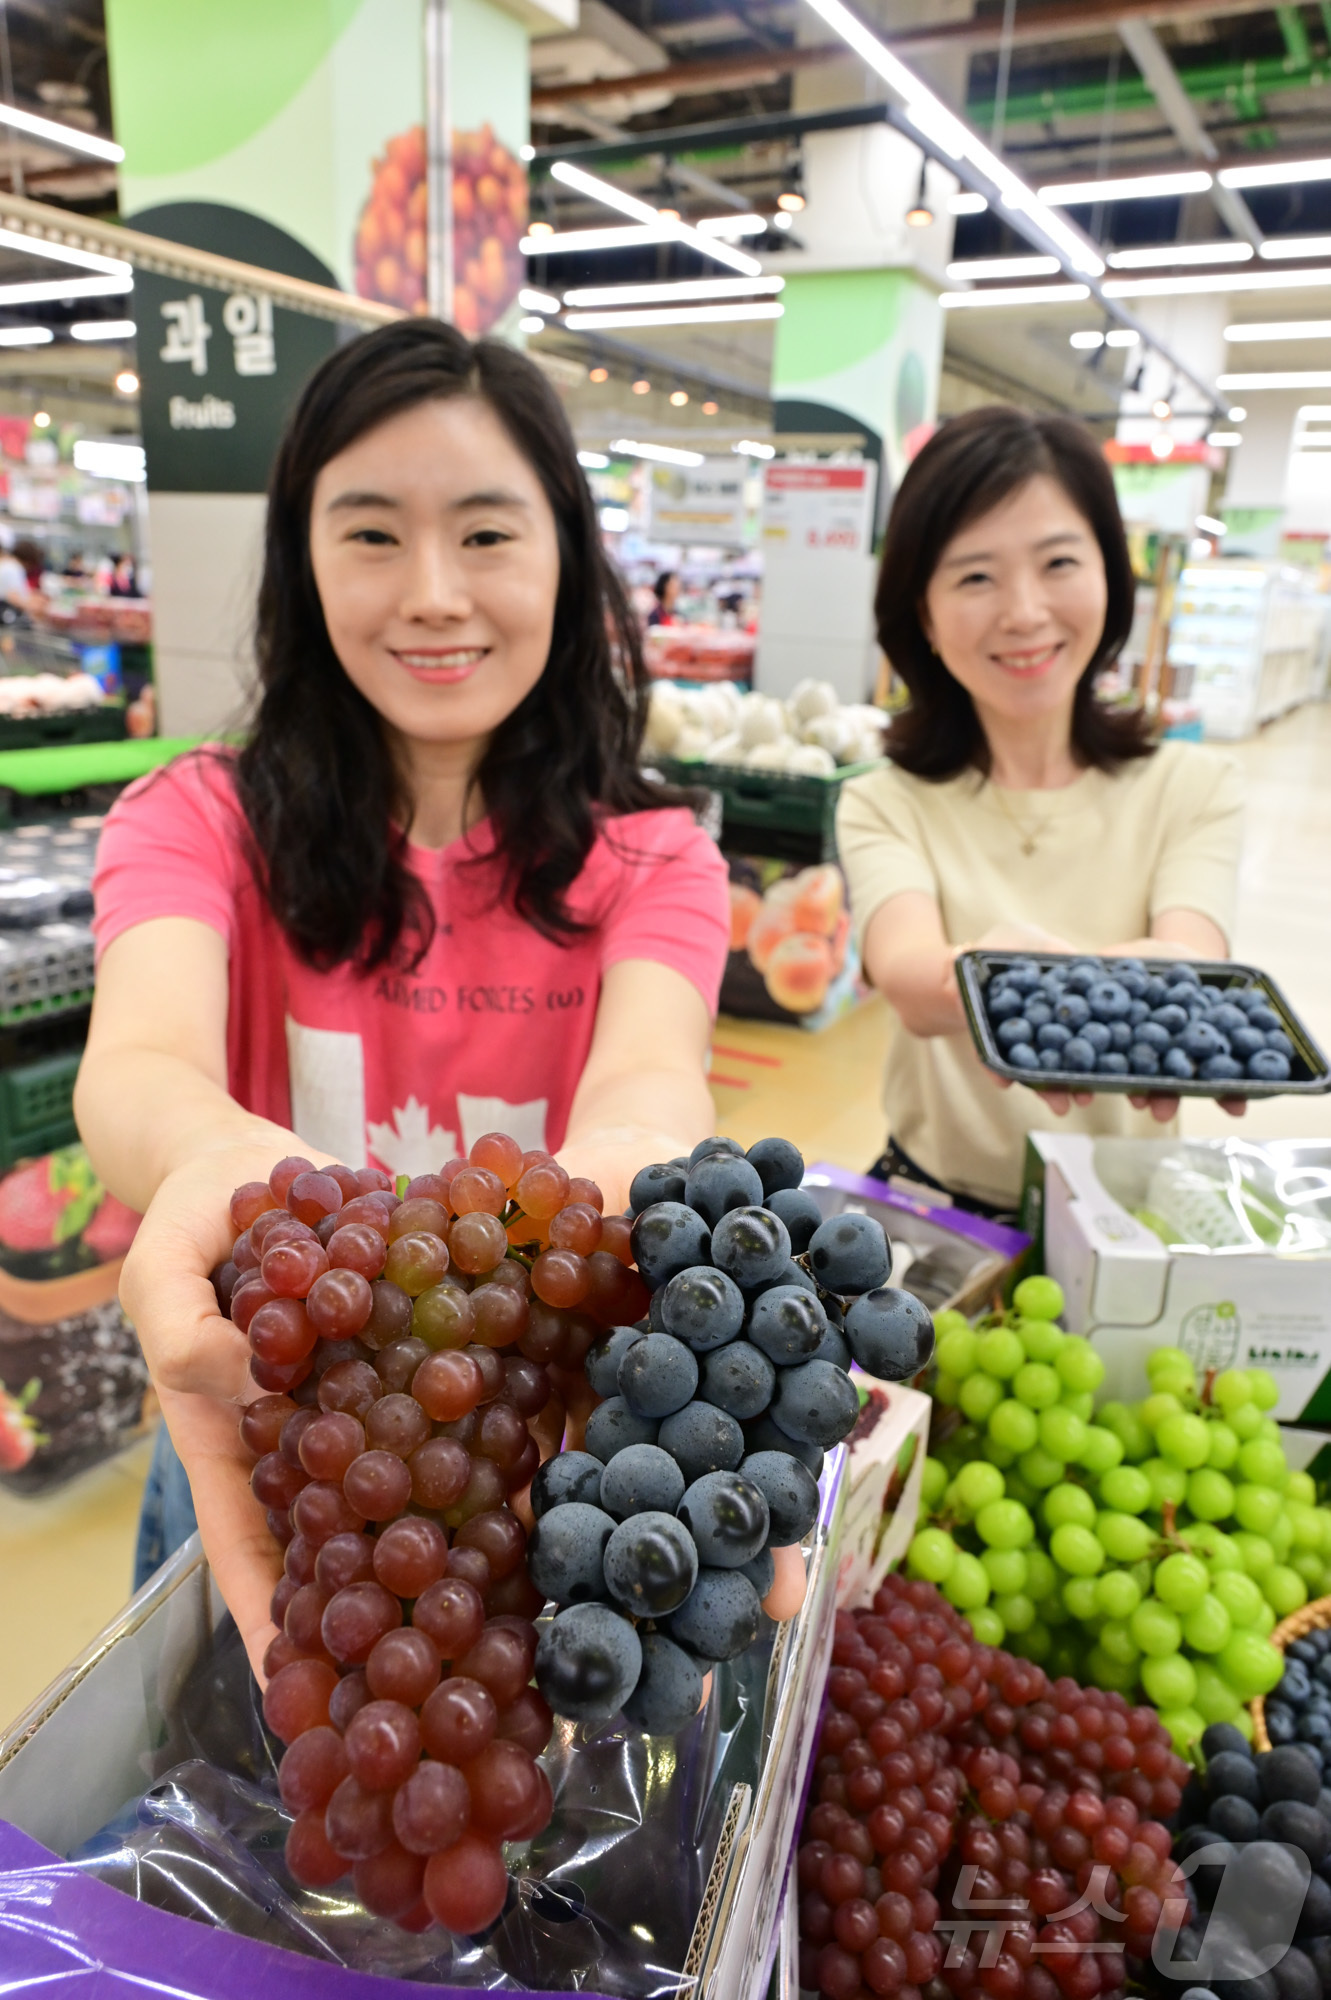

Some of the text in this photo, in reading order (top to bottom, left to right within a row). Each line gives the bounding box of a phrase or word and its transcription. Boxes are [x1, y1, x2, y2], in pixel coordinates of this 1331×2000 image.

[160, 294, 277, 376] 과일
[169, 395, 235, 429] Fruits
[457, 984, 535, 1014] FORCES
